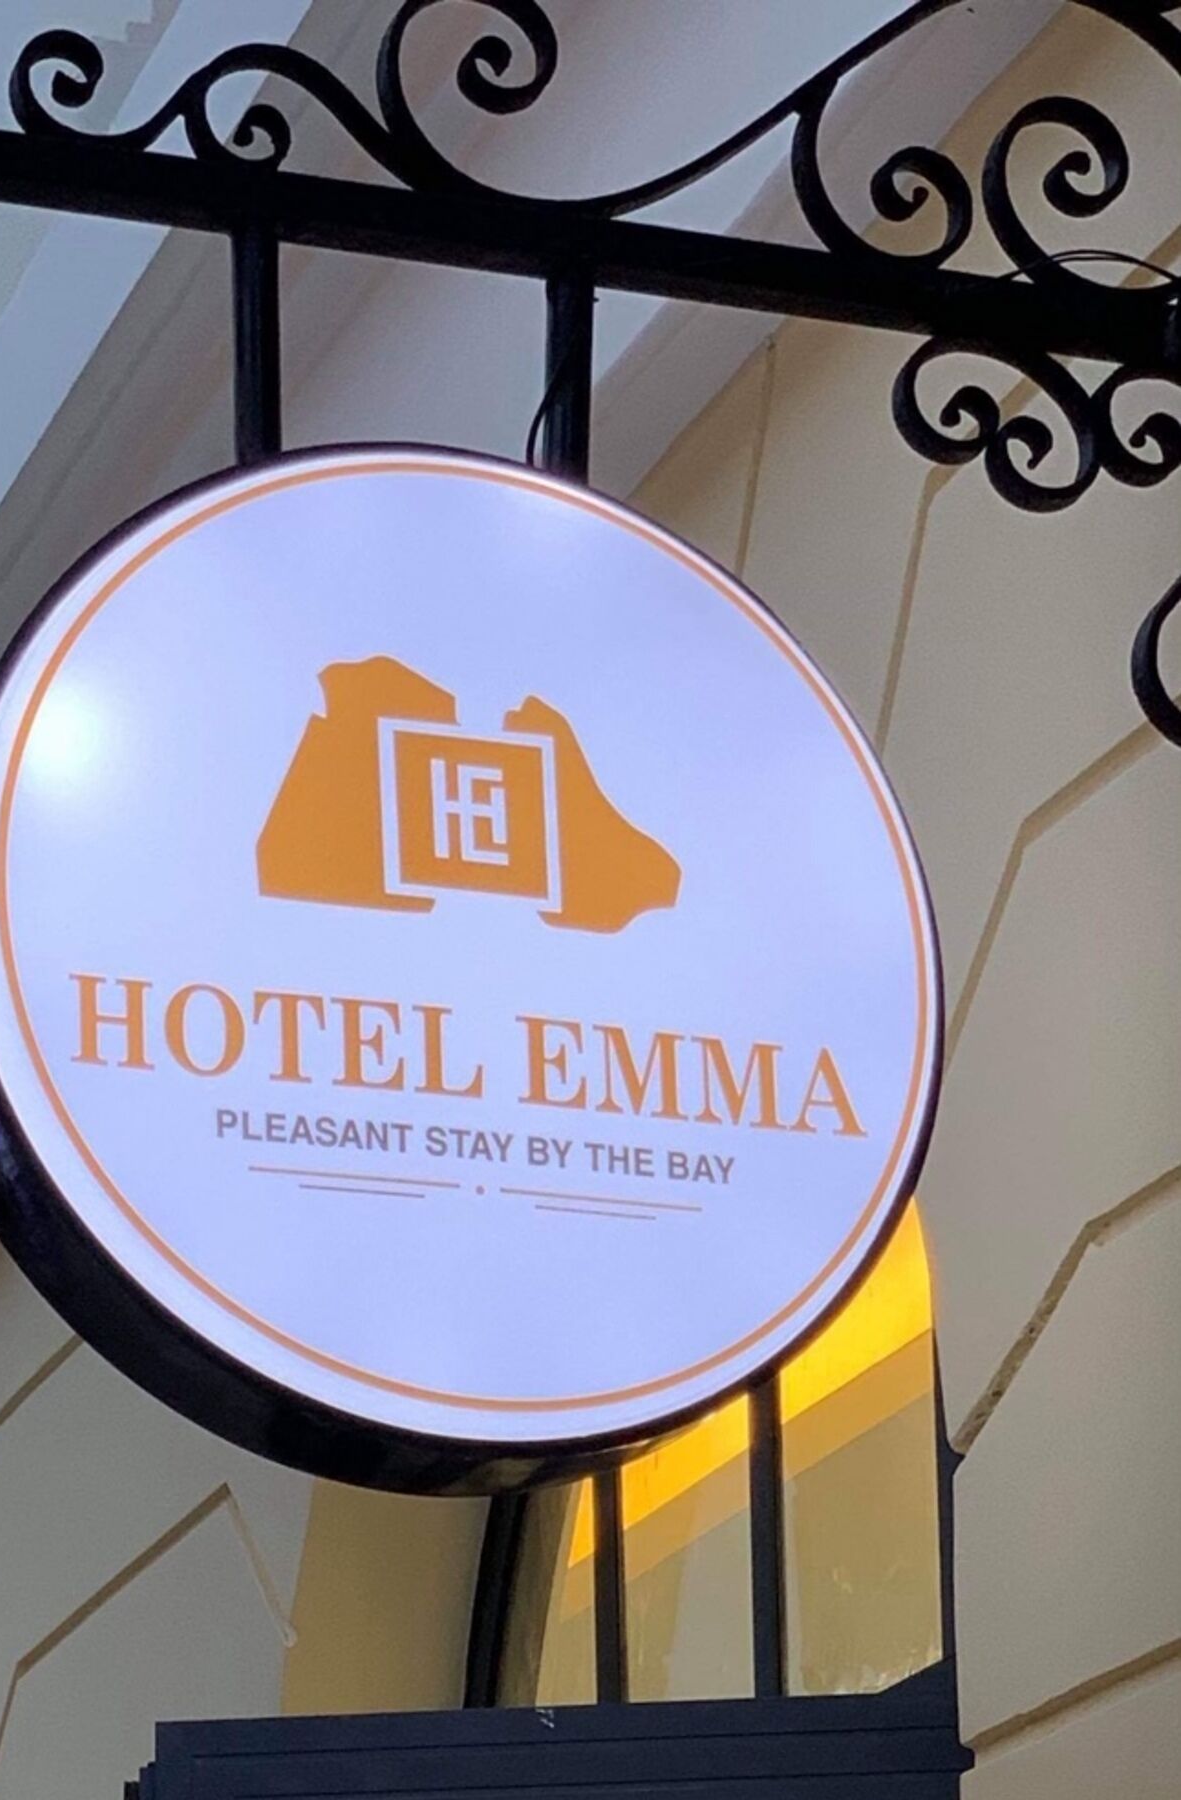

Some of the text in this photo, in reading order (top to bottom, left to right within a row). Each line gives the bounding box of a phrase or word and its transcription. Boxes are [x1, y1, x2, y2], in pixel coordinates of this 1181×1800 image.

[68, 972, 868, 1139] HOTEL EMMA
[216, 1109, 736, 1186] PLEASANT STAY BY THE BAY
